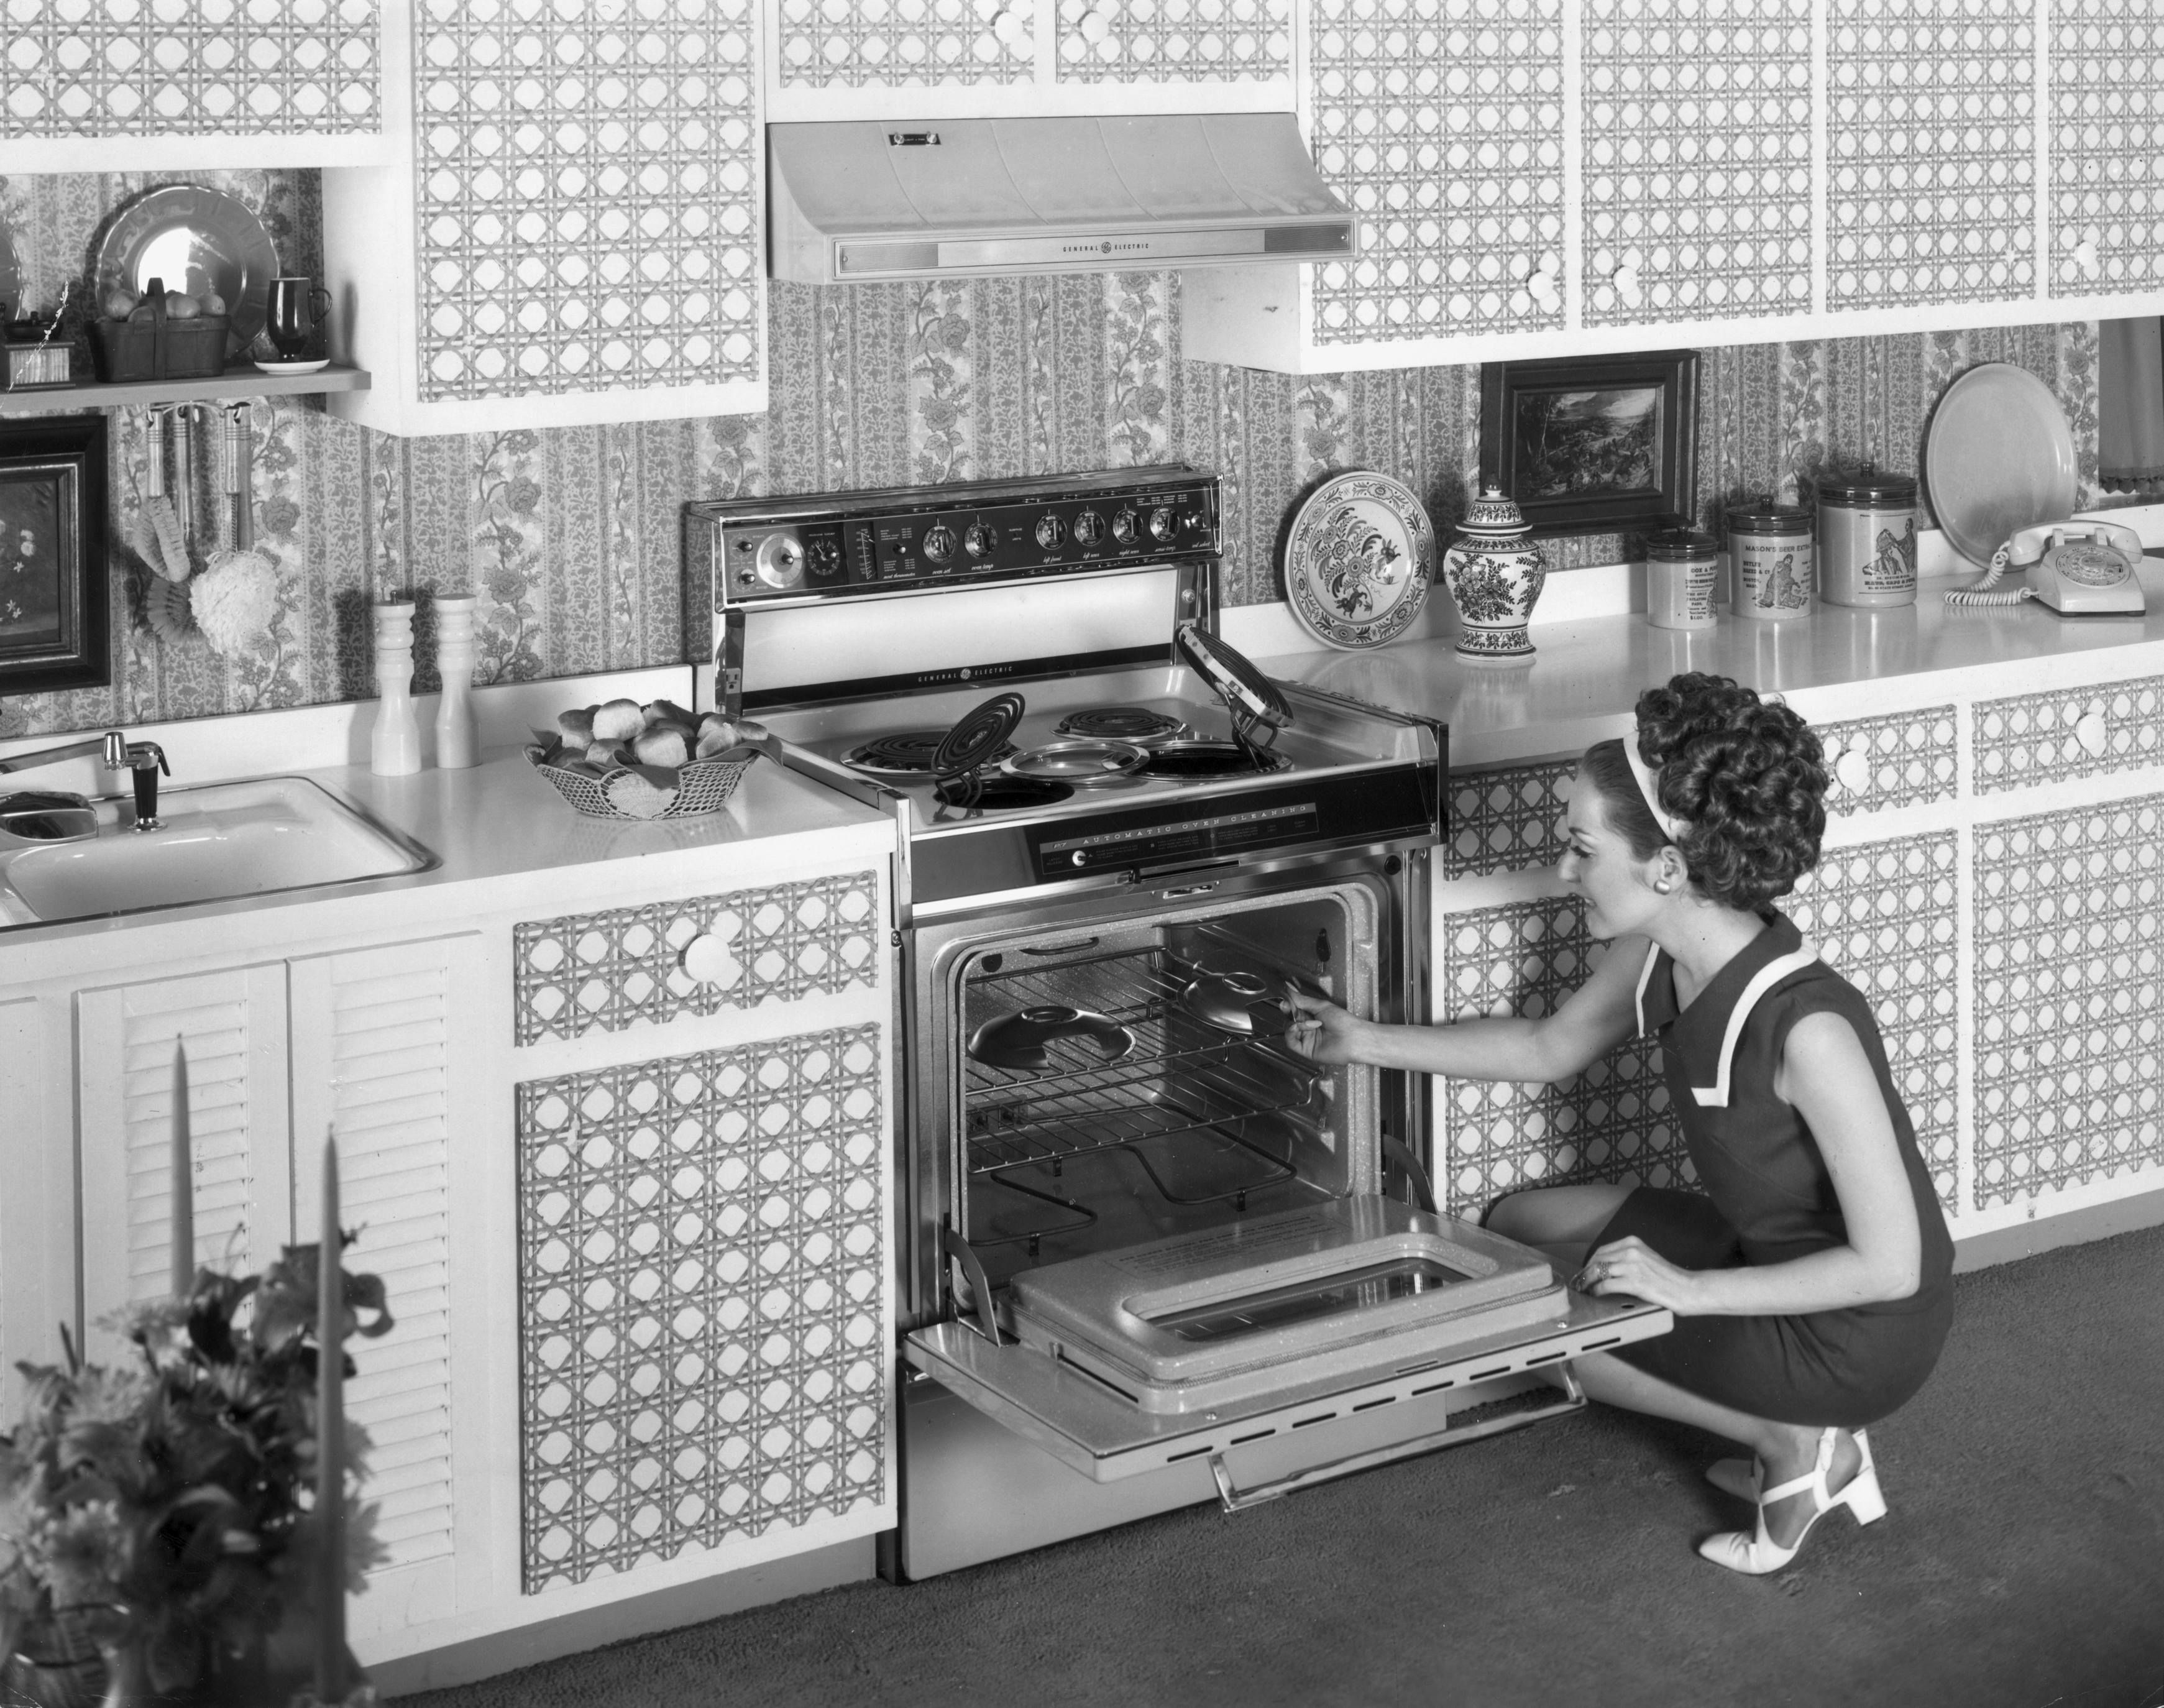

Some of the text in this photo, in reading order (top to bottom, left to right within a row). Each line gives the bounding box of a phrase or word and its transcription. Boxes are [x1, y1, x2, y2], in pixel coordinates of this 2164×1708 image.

[918, 673, 956, 682] GENERAL
[974, 666, 1012, 676] ELECTRIC
[1083, 827, 1171, 844] AUTOMATIC
[1182, 819, 1219, 829] OVEN
[1231, 806, 1306, 822] CLEANING
